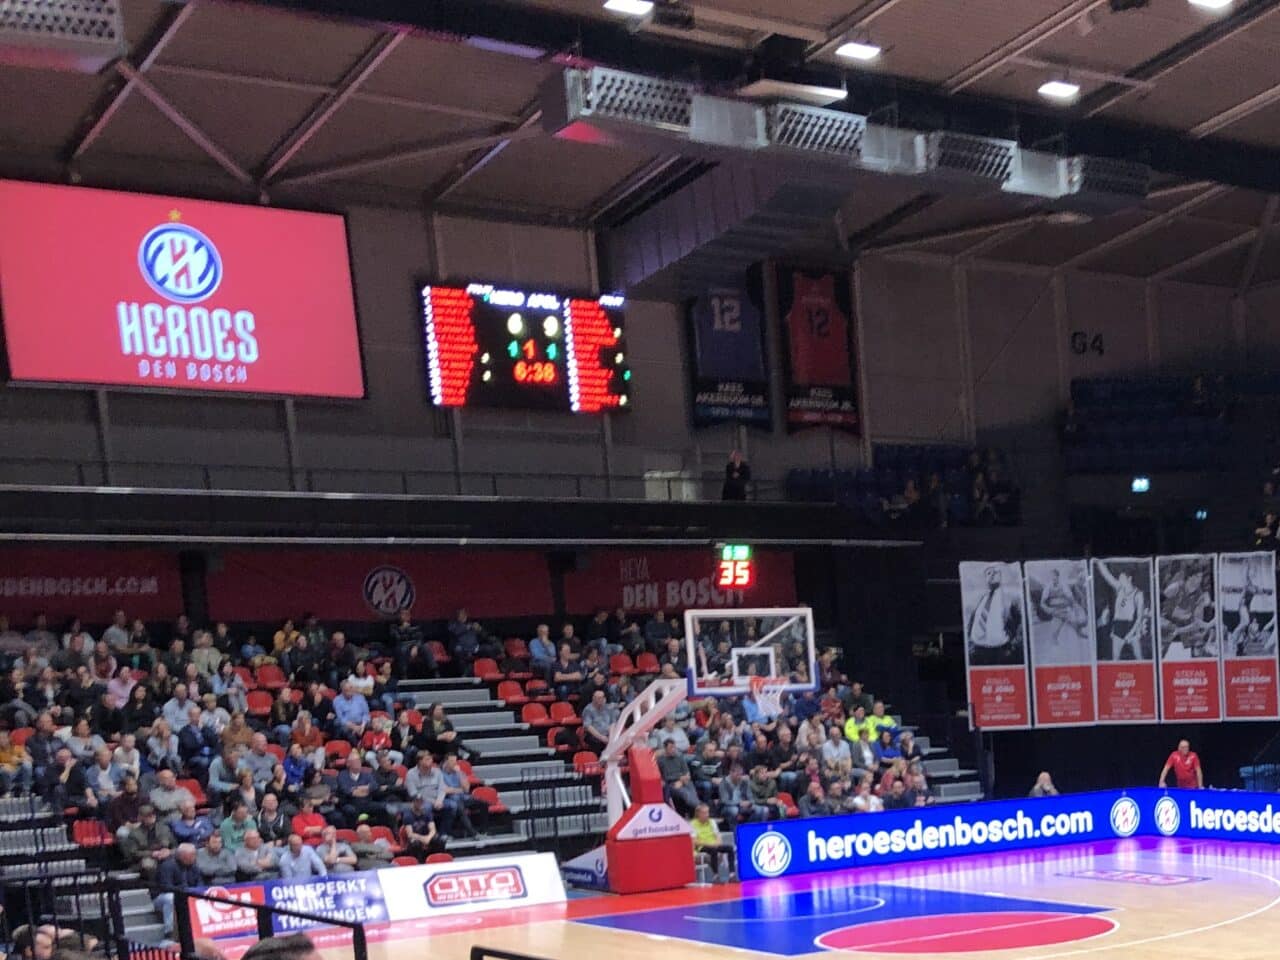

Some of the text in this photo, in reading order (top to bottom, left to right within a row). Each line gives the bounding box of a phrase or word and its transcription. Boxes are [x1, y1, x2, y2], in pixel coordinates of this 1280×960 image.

[711, 297, 742, 332] 12
[116, 301, 259, 364] HEROES
[1071, 332, 1105, 358] G4
[138, 359, 248, 383] DEN BOSCH
[719, 561, 750, 585] 35
[623, 581, 659, 609] DEN
[806, 808, 1094, 864] heroesdenbosch.com
[434, 872, 515, 893] OTTO
